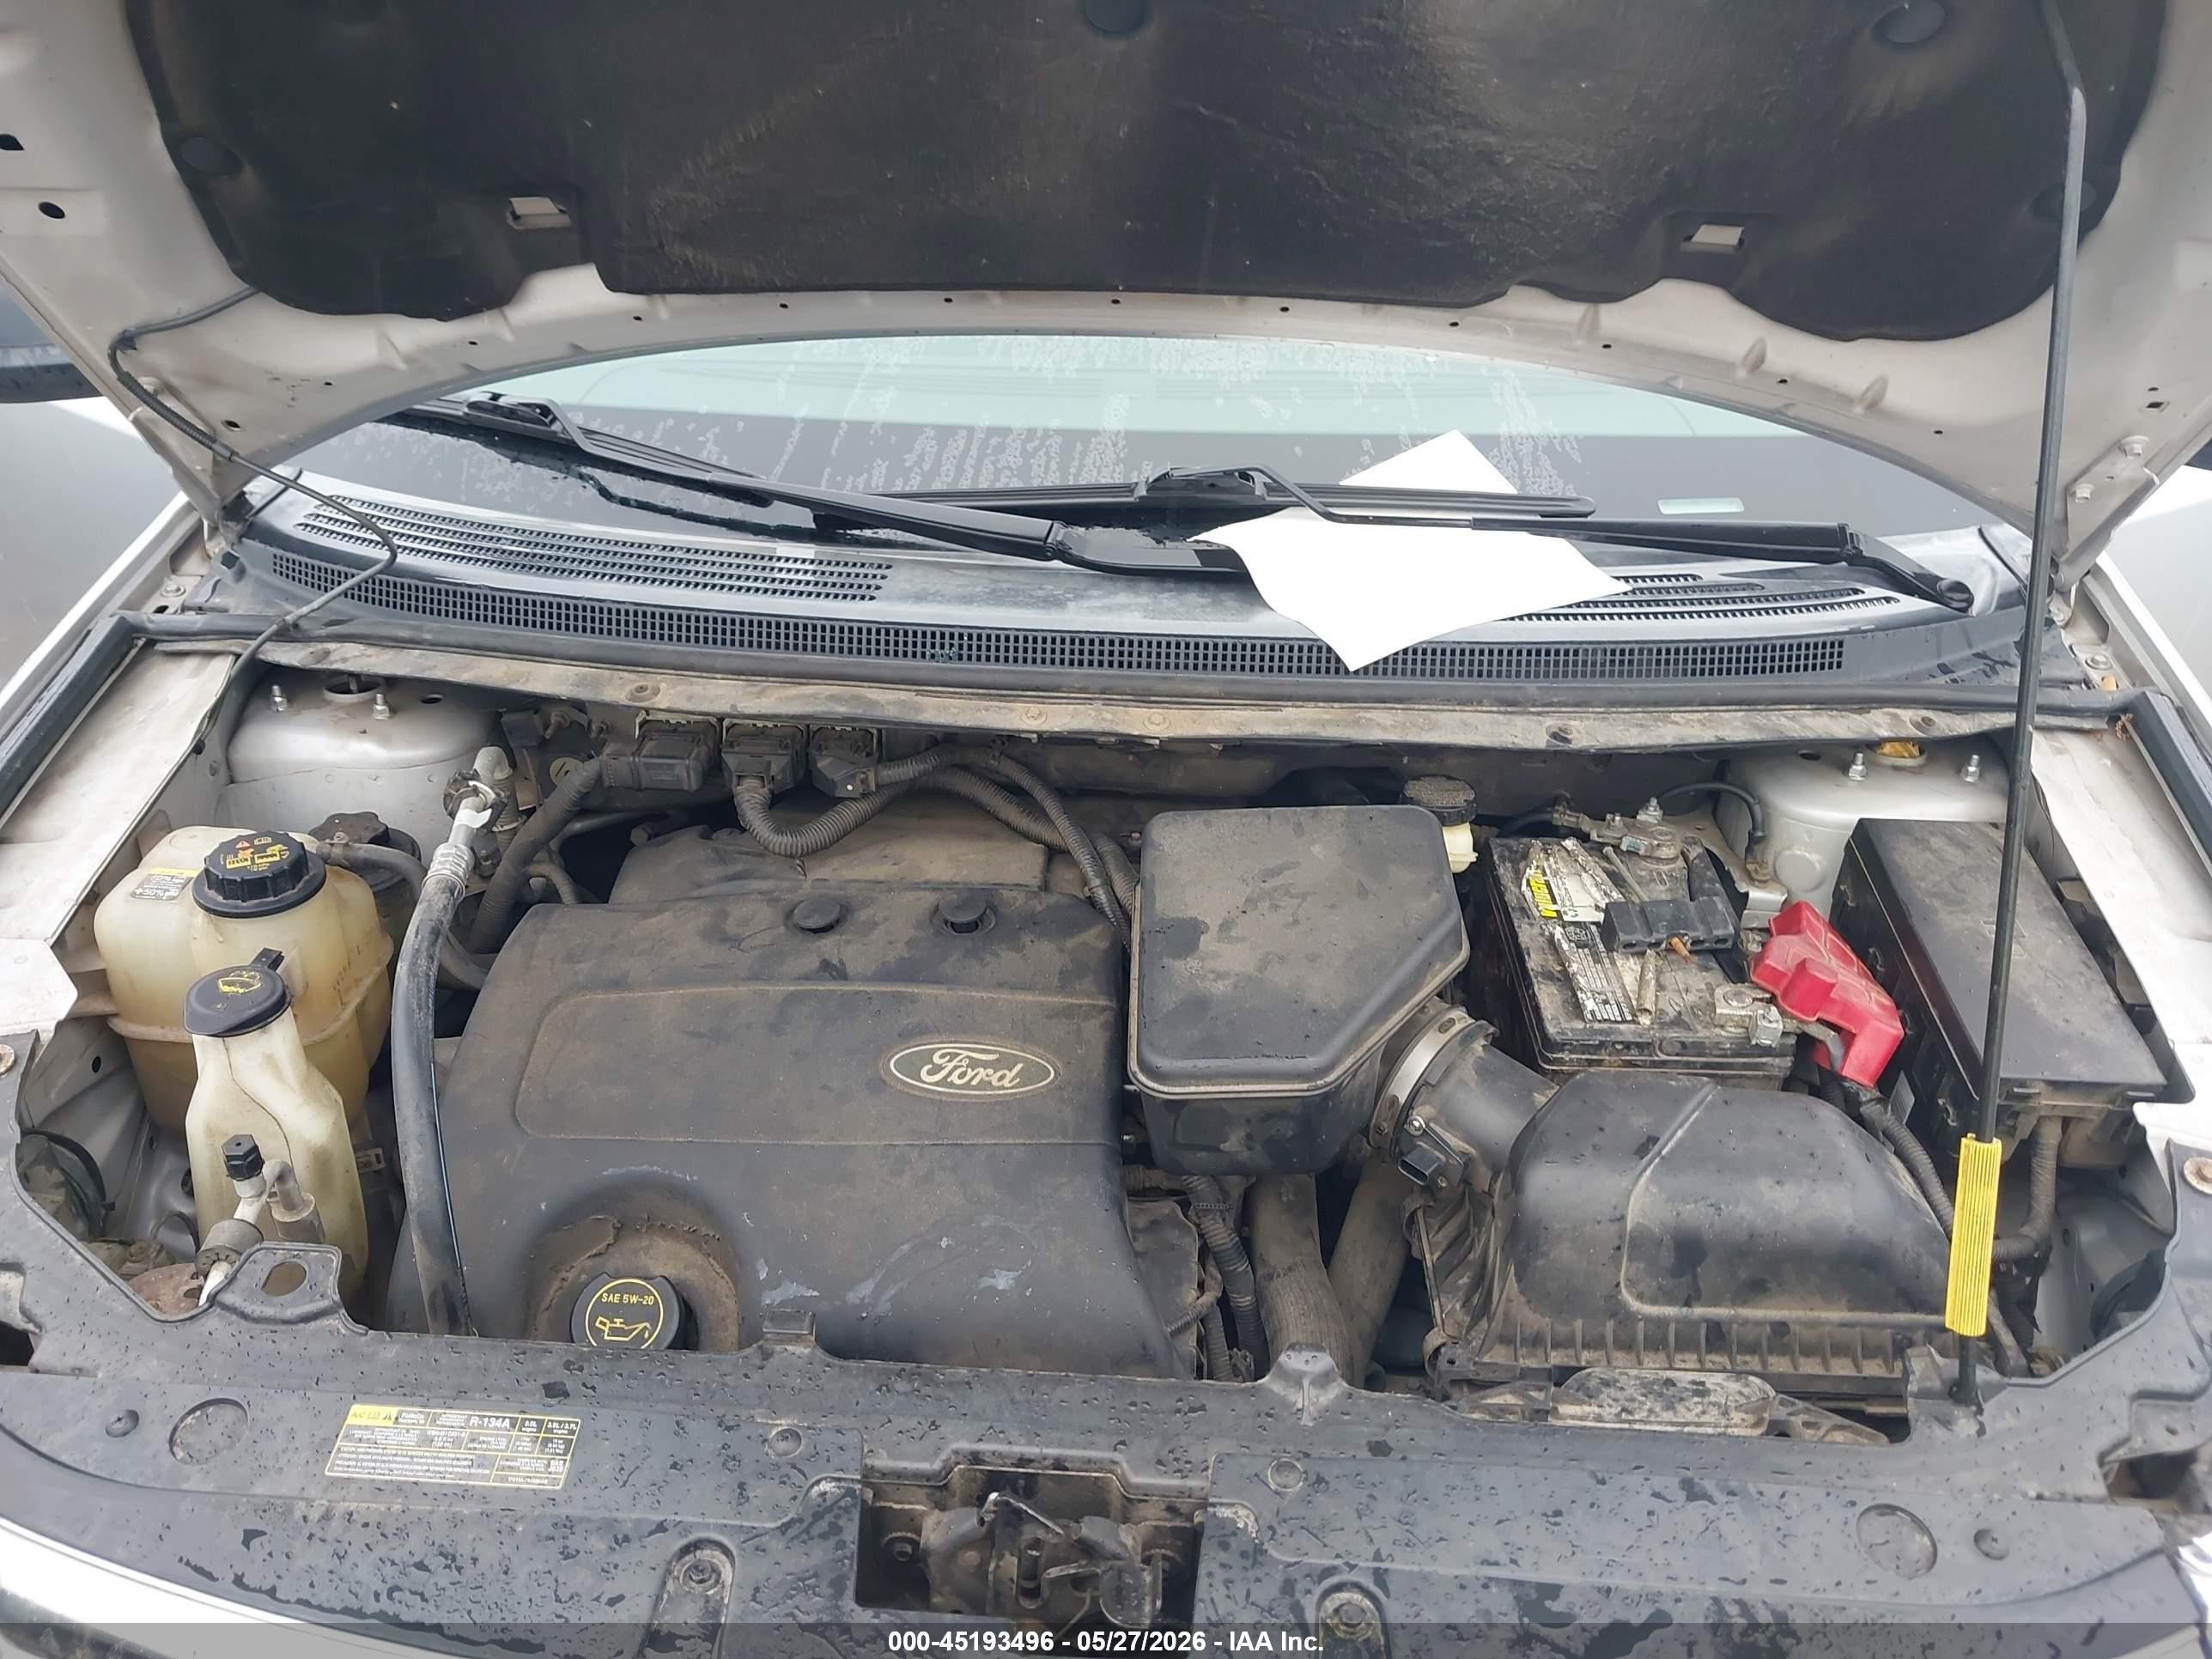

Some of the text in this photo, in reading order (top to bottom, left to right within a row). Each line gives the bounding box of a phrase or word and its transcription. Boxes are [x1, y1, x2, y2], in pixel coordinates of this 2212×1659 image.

[920, 1048, 1022, 1087] Ford
[601, 1292, 654, 1305] SAE 5W-20
[469, 1416, 511, 1430] R-134A
